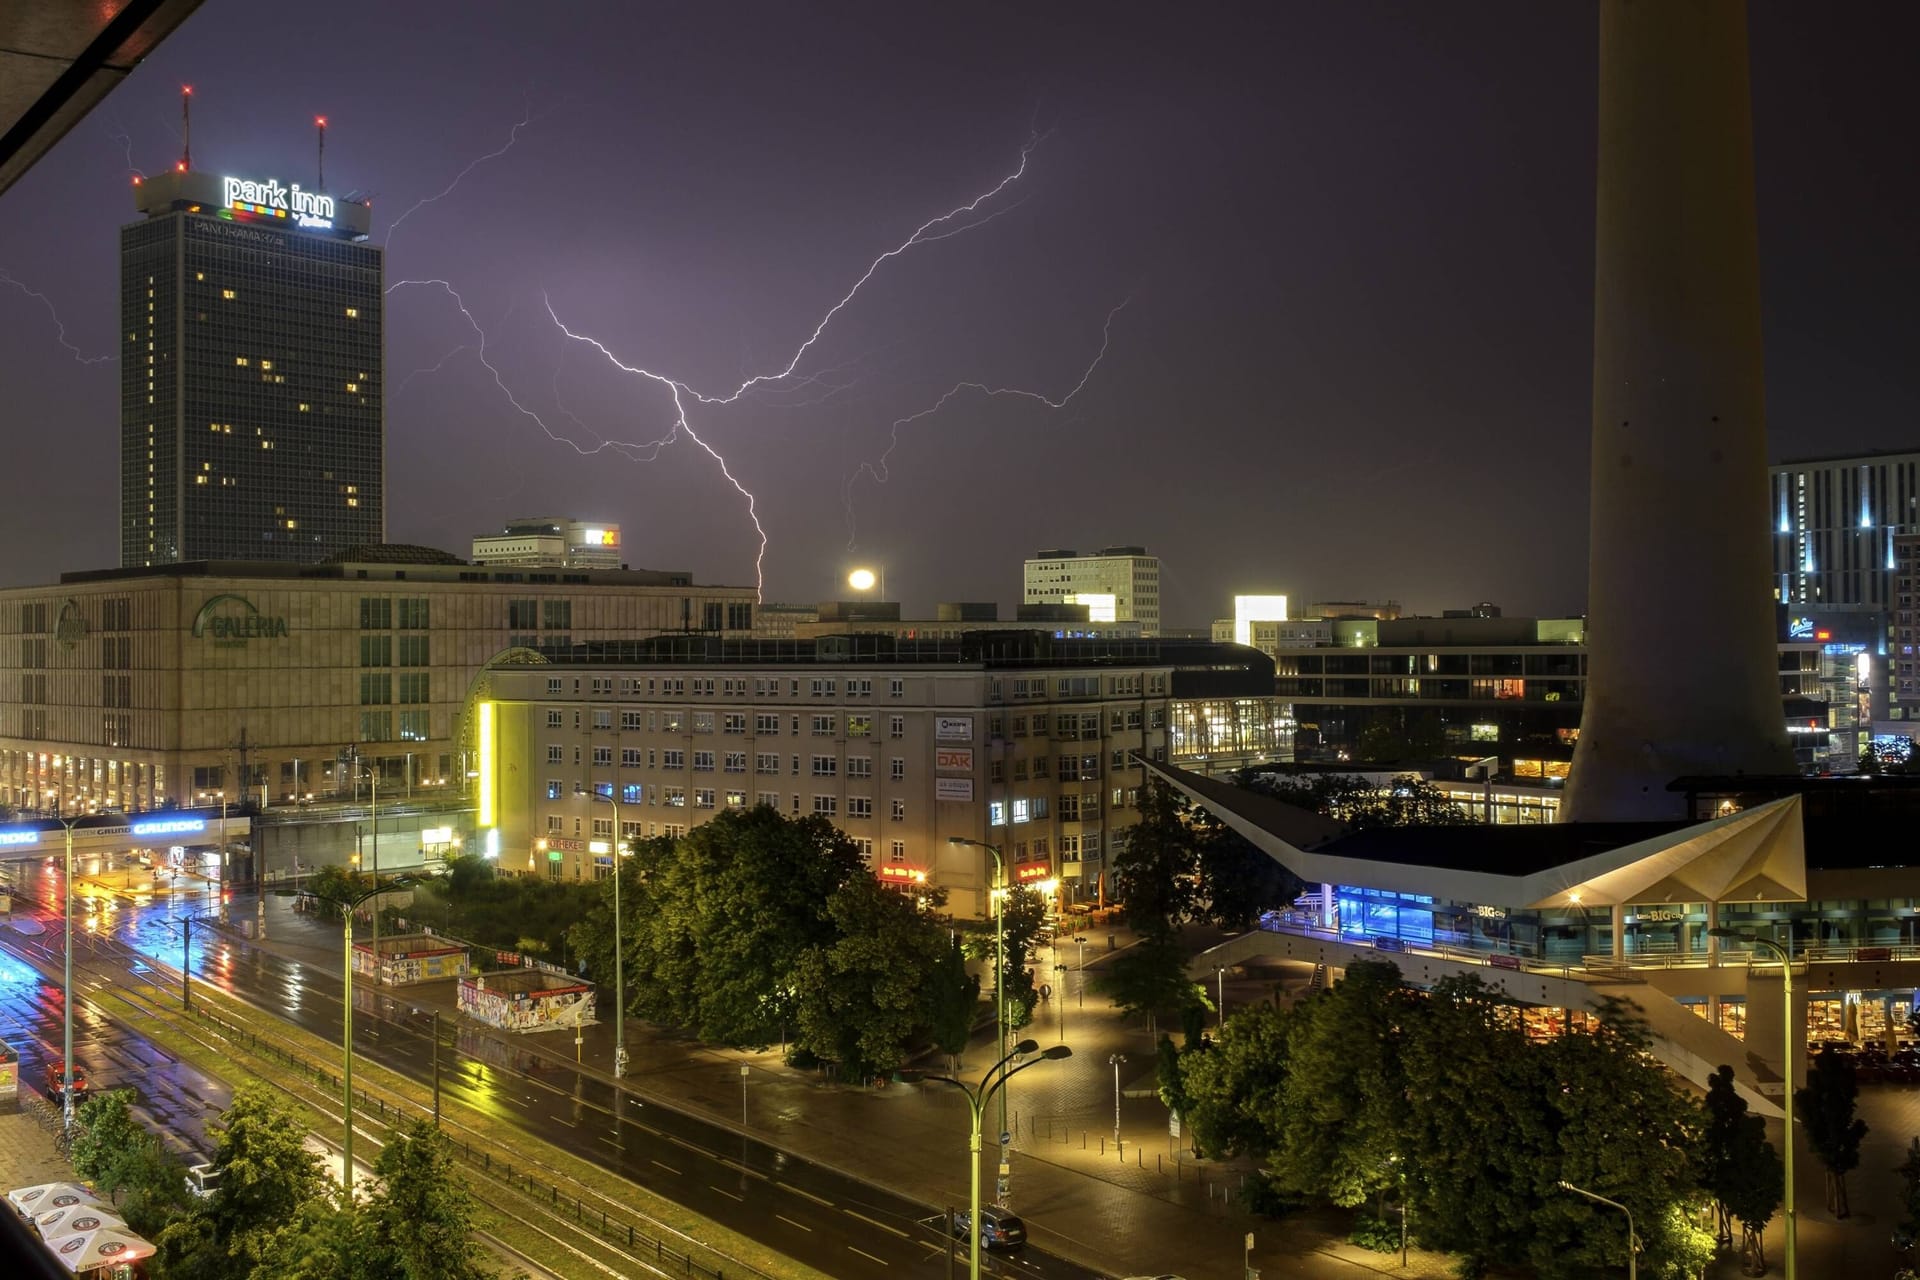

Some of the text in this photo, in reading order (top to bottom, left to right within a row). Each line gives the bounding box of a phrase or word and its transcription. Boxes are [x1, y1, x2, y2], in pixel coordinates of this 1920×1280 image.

[224, 177, 334, 218] park inn
[212, 616, 289, 638] GALERIA
[937, 752, 971, 768] DAK
[96, 827, 131, 835] GRUND
[134, 820, 205, 834] GRUNDIG
[0, 831, 38, 845] NDIG
[1477, 905, 1495, 918] BIG
[1650, 910, 1671, 921] BIG
